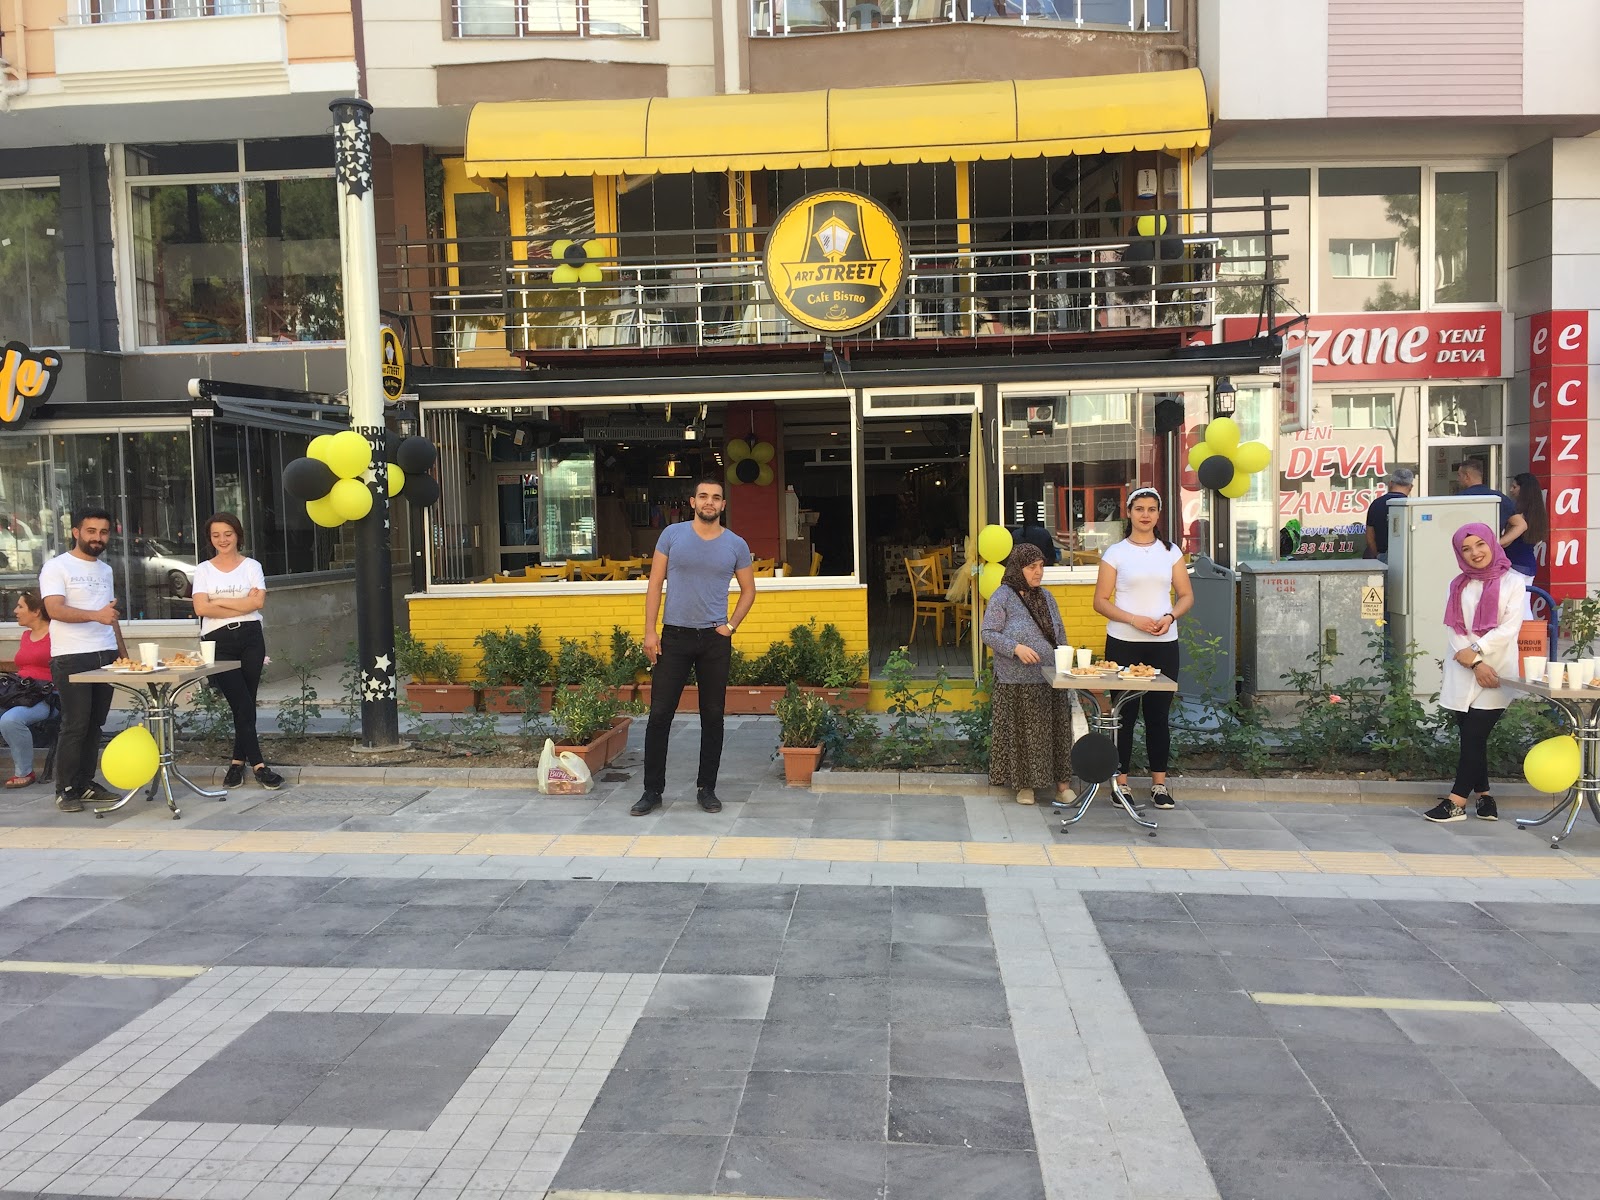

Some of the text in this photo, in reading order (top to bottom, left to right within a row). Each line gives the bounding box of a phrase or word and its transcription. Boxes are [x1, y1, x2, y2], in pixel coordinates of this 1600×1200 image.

[794, 263, 877, 282] ART STREET
[1438, 325, 1486, 344] YENİ
[1437, 348, 1486, 363] DEVA
[1284, 444, 1388, 479] DEVA
[1318, 541, 1335, 553] 41
[1338, 540, 1354, 553] 11
